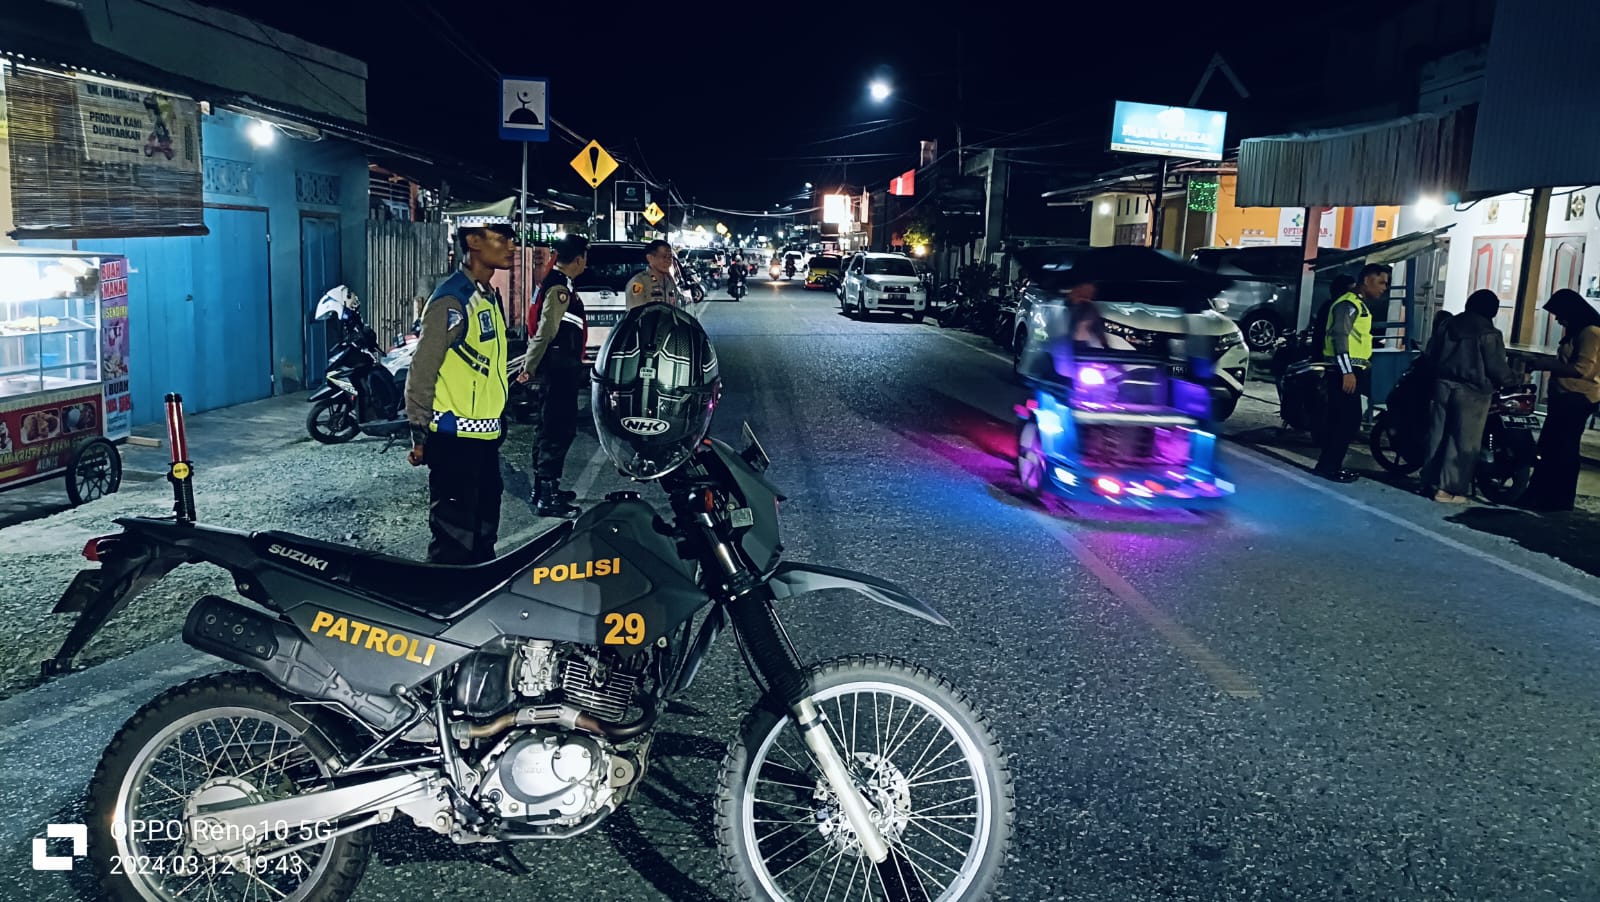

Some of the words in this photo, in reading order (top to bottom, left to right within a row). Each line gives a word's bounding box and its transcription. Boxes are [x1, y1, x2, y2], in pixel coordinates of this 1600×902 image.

[89, 112, 121, 125] PRODUK
[268, 544, 329, 571] SUZUKI
[533, 558, 620, 585] POLISI
[311, 611, 436, 666] PATROLI
[604, 612, 646, 645] 29
